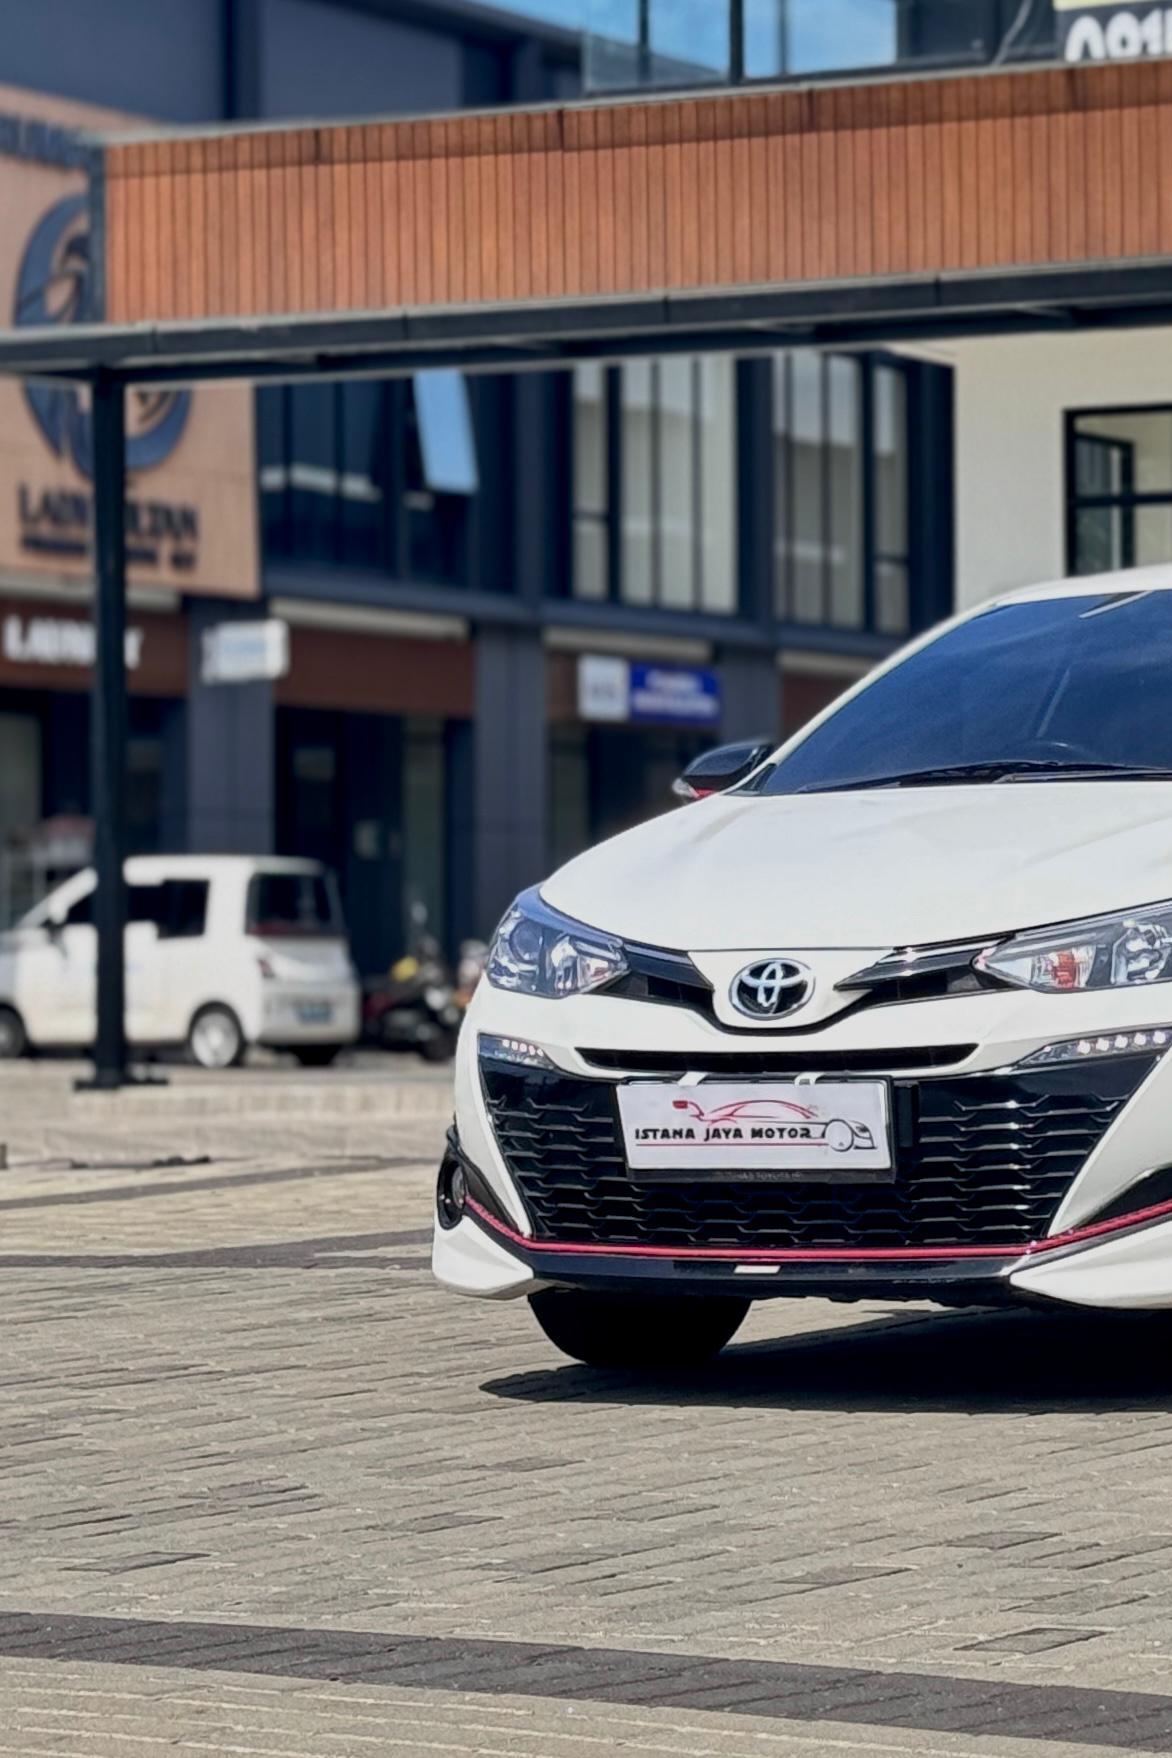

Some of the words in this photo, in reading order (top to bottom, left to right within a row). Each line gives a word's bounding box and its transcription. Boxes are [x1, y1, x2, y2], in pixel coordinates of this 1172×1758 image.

[634, 1127, 696, 1141] ISTANA
[703, 1127, 744, 1142] JAYA
[750, 1127, 812, 1140] MOTOR
